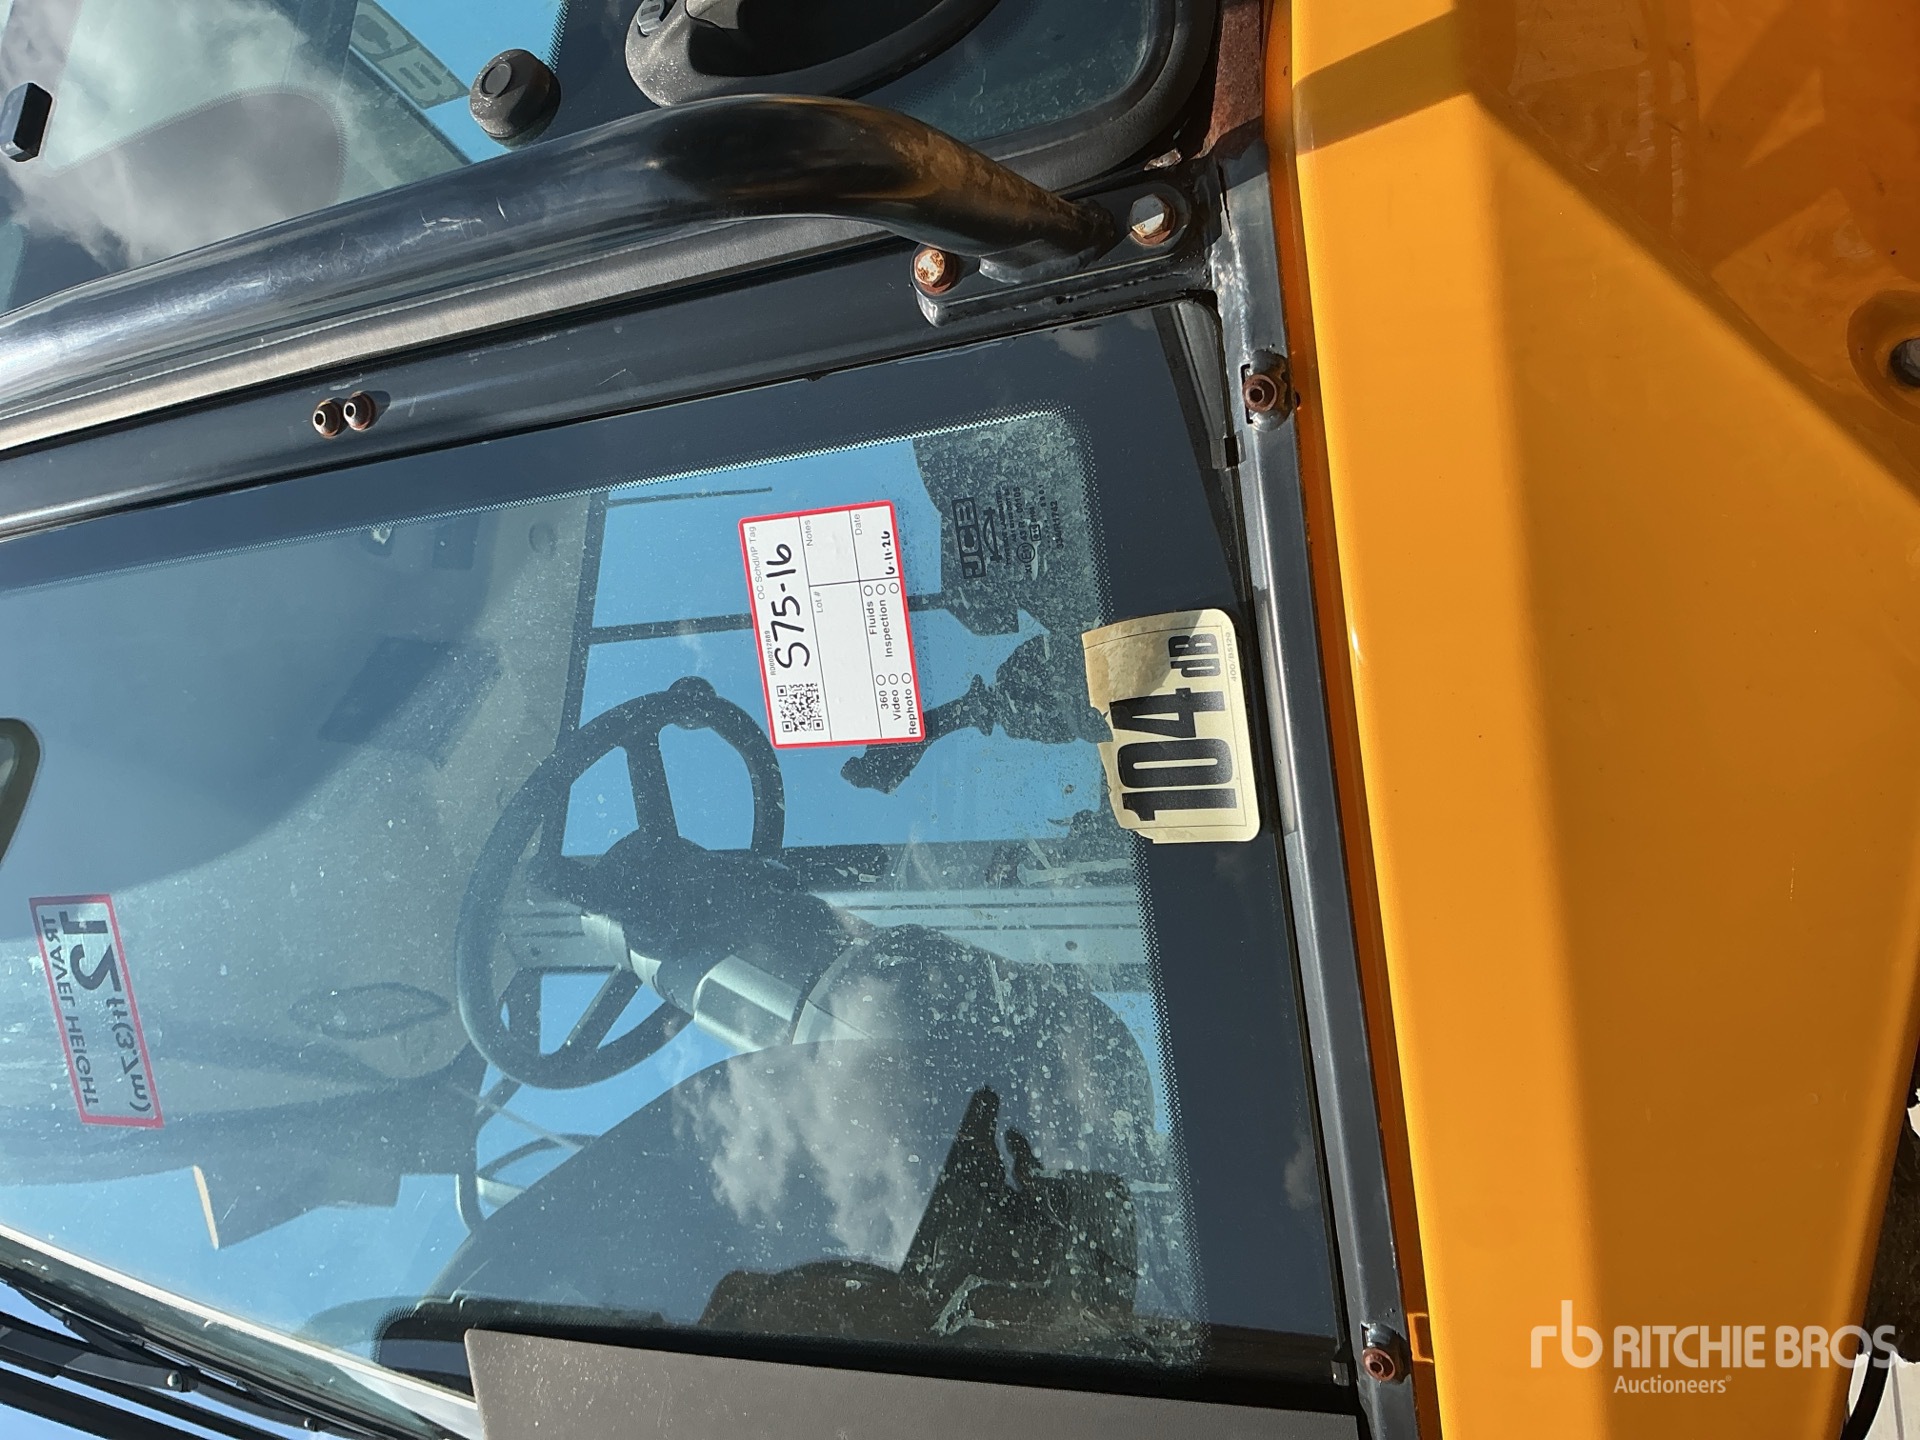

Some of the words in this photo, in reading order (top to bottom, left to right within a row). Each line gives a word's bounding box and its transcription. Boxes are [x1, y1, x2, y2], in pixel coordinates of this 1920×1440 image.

[748, 526, 757, 543] Tag
[804, 519, 813, 547] Notes
[853, 513, 862, 535] Date
[953, 498, 985, 578] JCB
[757, 584, 766, 600] OC
[766, 543, 811, 668] S75-16
[814, 598, 824, 613] Lot
[865, 600, 877, 635] Fluids
[879, 599, 893, 658] Inspection
[1168, 633, 1221, 678] dB
[878, 690, 889, 710] 360
[891, 689, 902, 721] Video
[904, 688, 918, 735] Rephoto
[1109, 688, 1237, 821] 104
